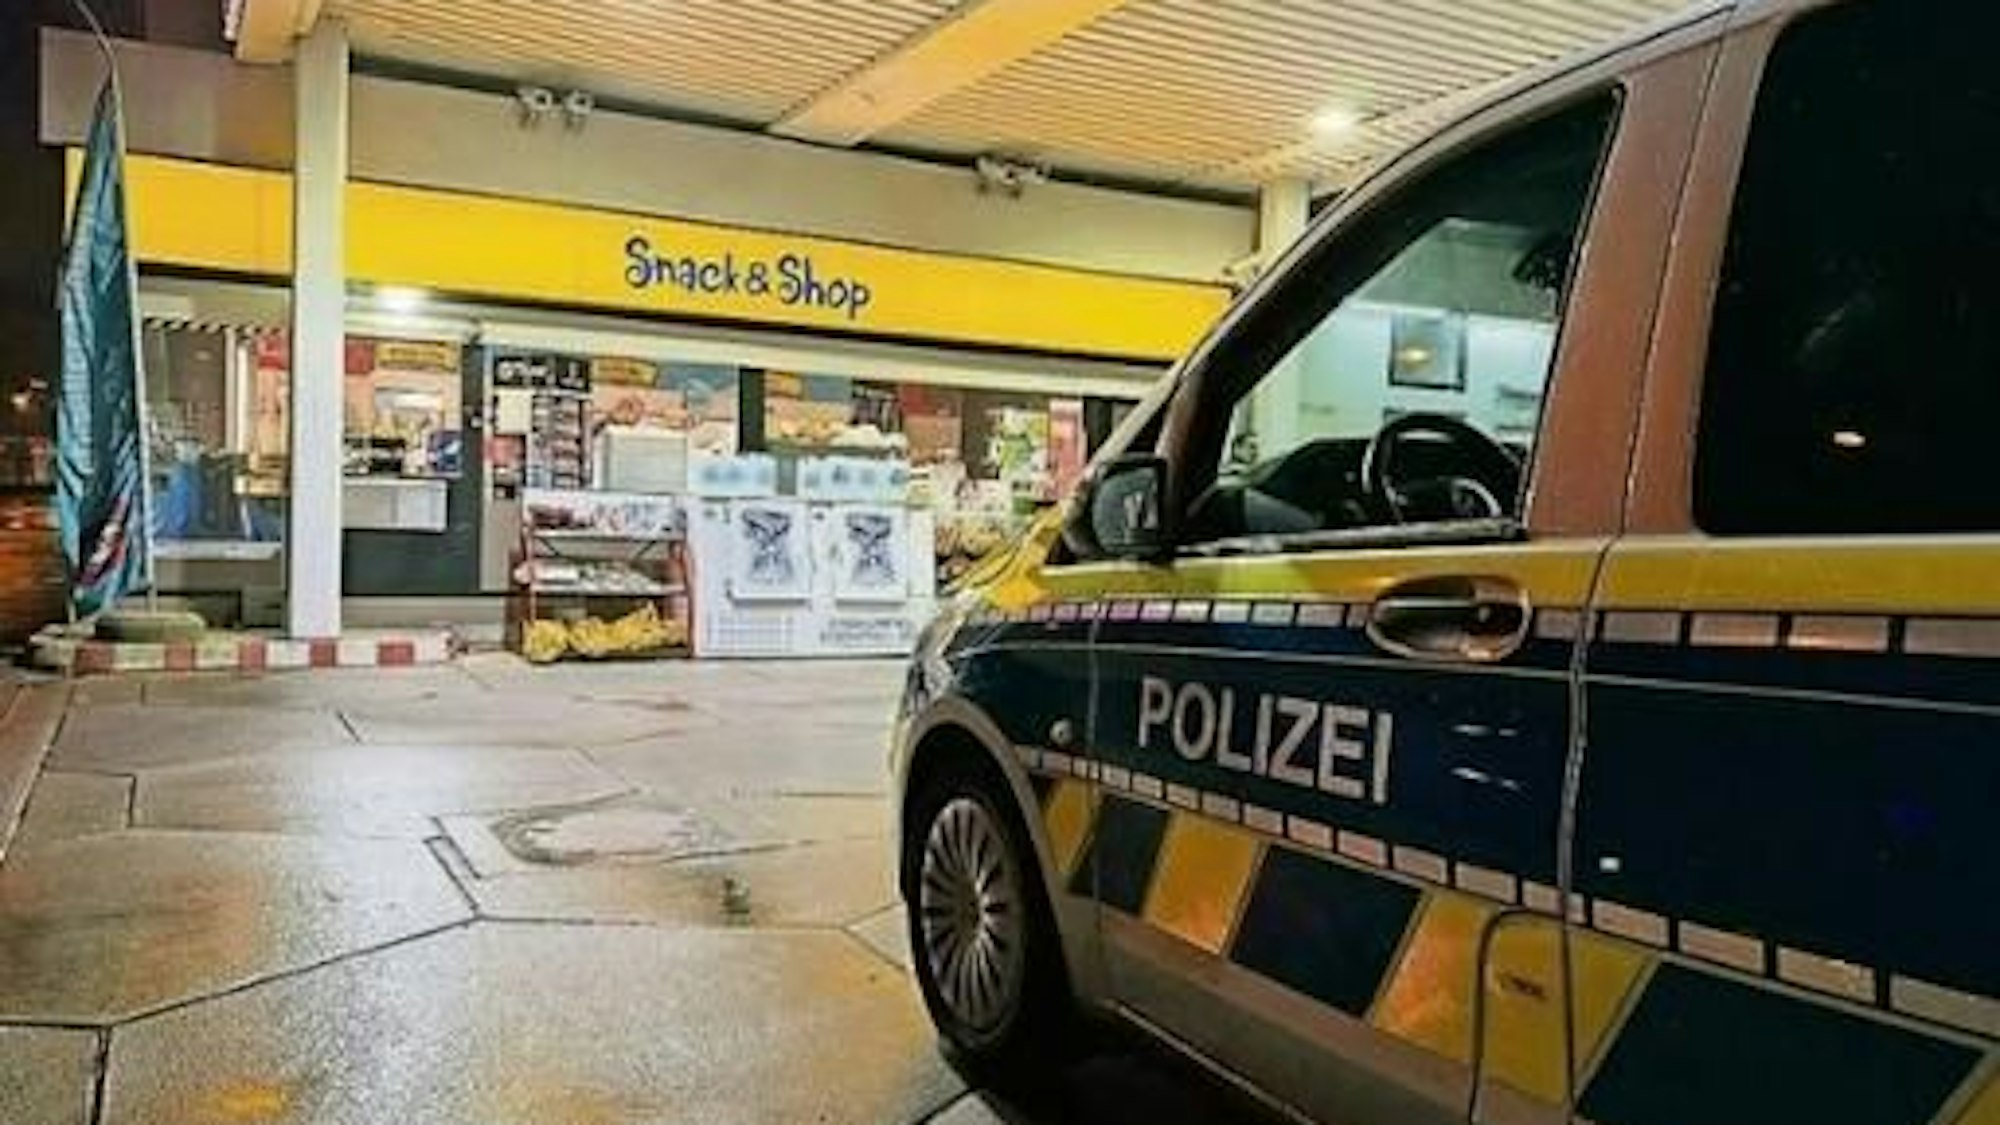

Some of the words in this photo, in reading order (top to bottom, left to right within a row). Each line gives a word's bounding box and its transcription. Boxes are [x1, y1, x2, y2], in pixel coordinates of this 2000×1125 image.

[625, 237, 739, 294] Snack
[778, 254, 870, 318] Shop
[1138, 677, 1392, 804] POLIZEI
